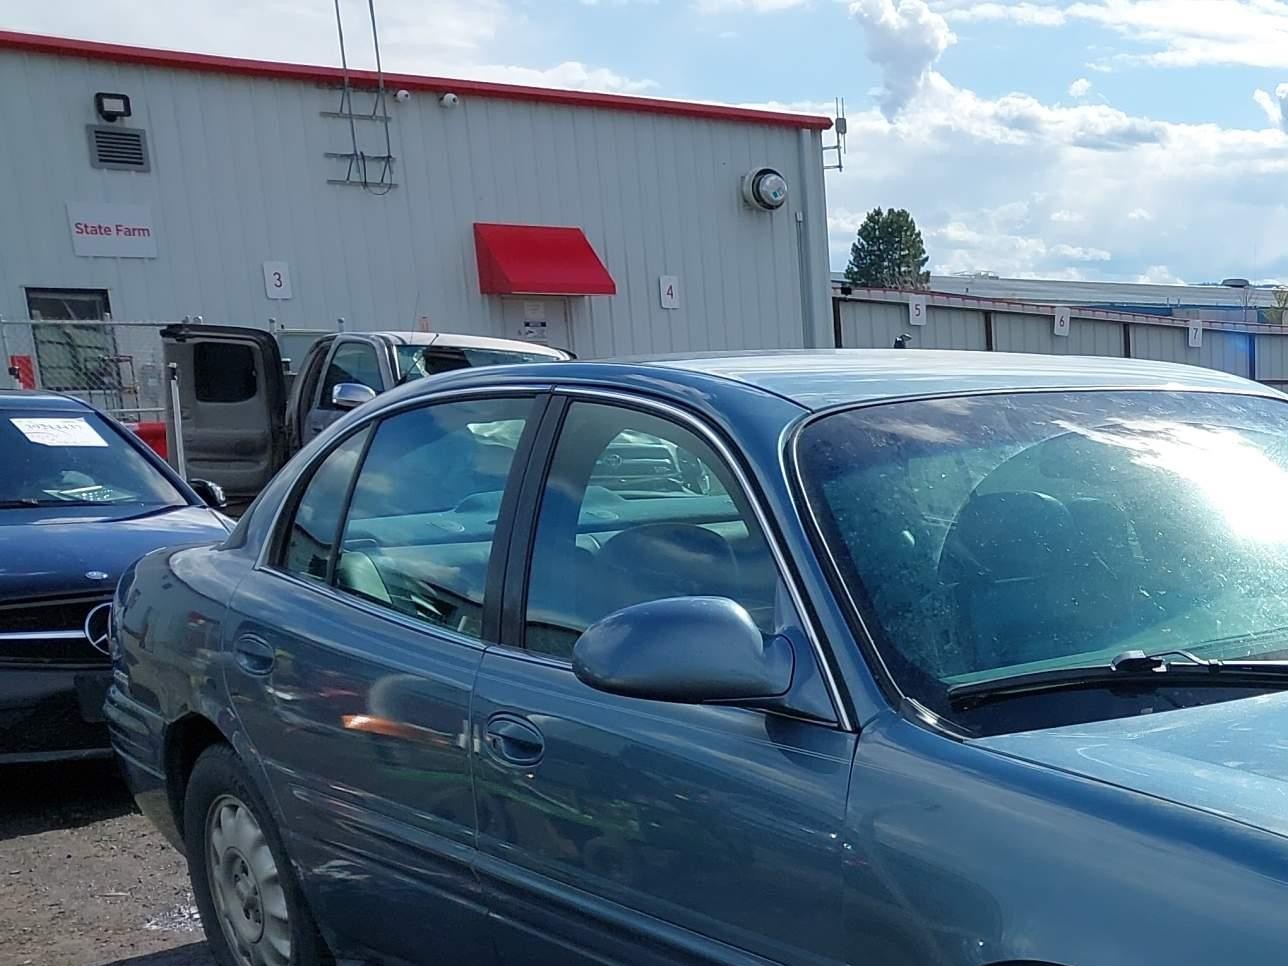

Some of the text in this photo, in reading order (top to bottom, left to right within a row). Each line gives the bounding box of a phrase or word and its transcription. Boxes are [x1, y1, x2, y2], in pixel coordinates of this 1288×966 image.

[74, 222, 151, 237] State Farm
[273, 271, 283, 288] 3
[666, 284, 674, 300] 4
[915, 303, 921, 317] 5
[1059, 317, 1065, 328] 6
[1193, 327, 1199, 340] 7
